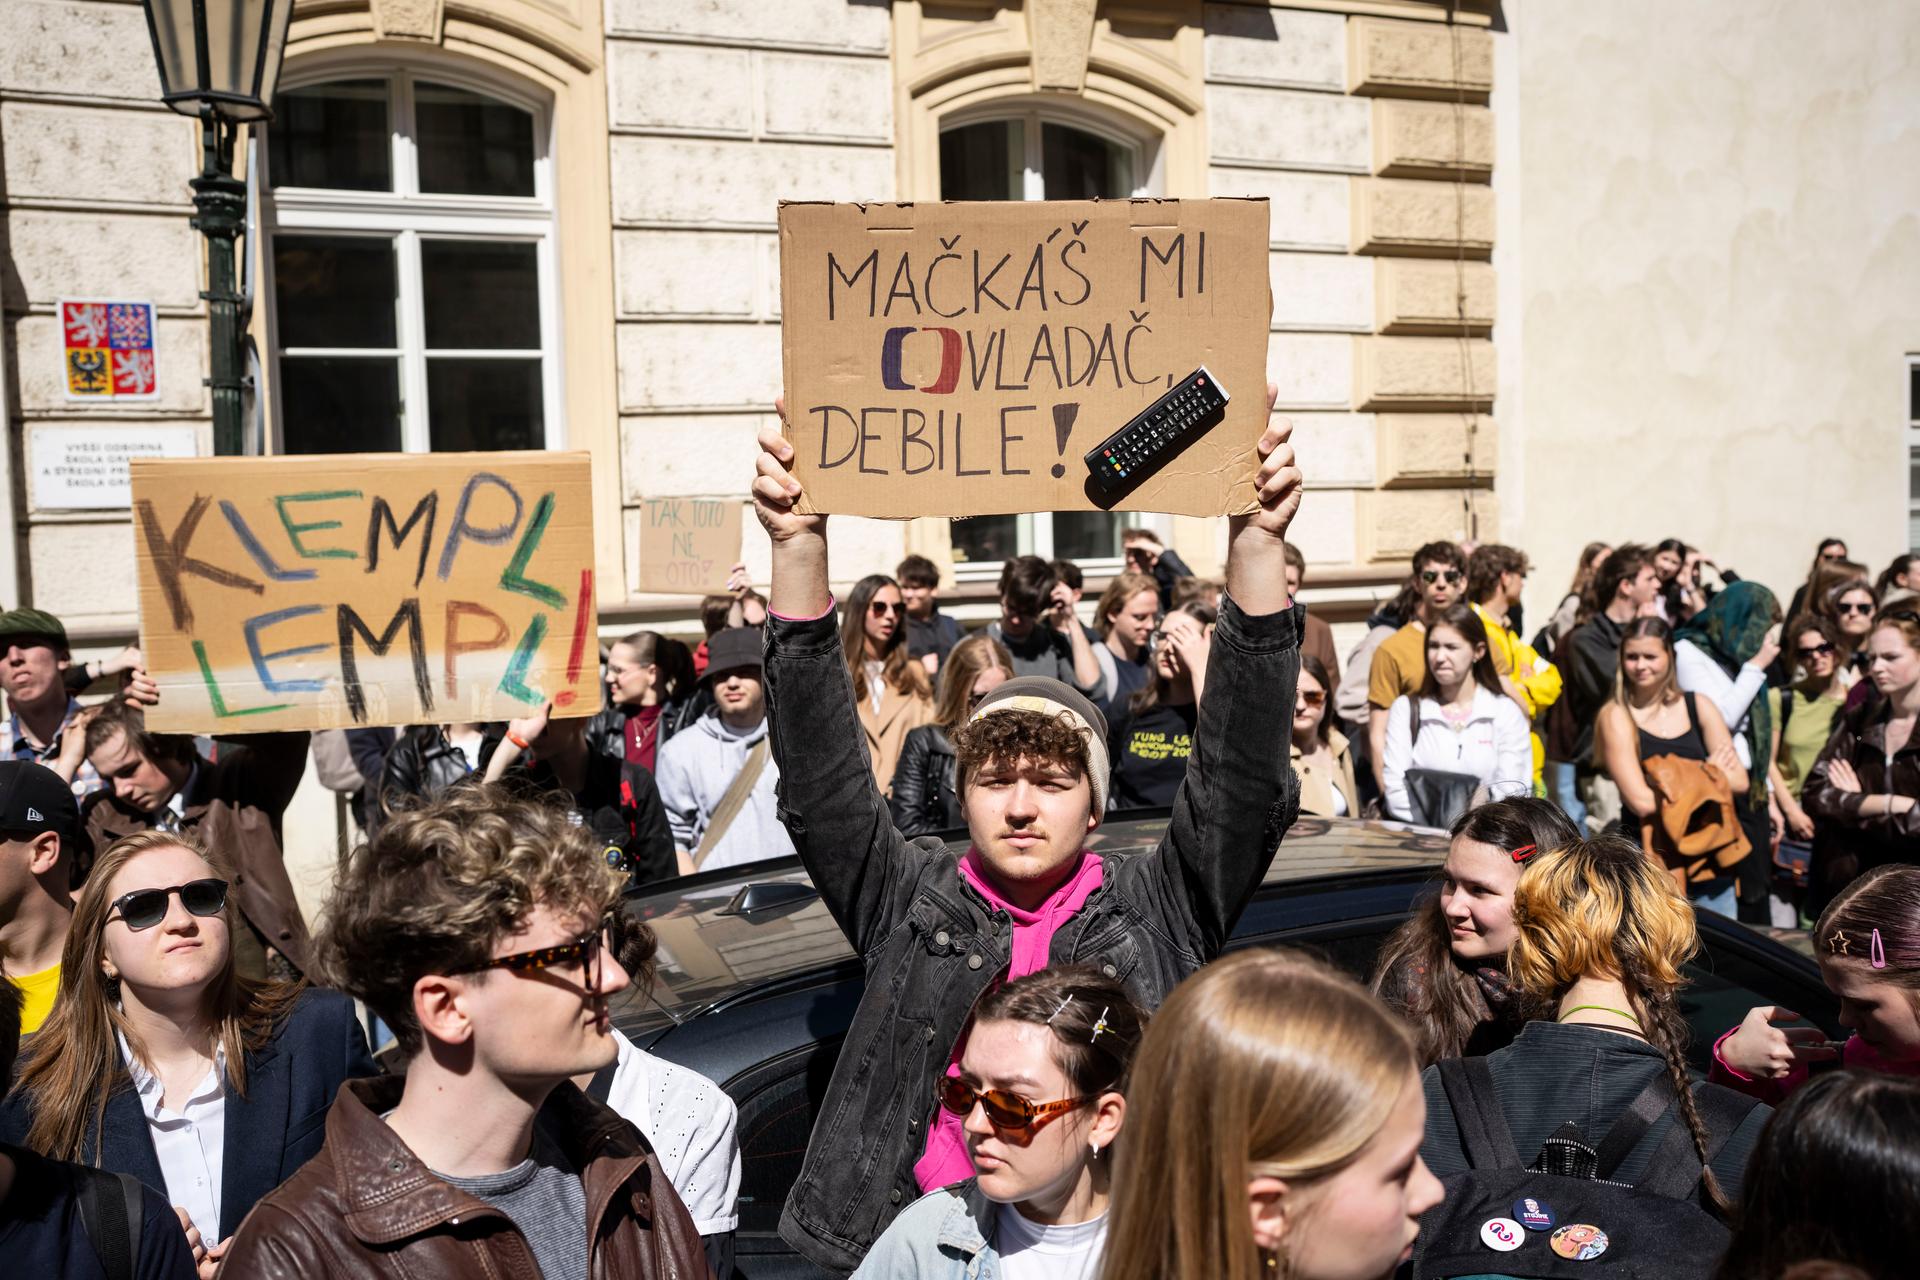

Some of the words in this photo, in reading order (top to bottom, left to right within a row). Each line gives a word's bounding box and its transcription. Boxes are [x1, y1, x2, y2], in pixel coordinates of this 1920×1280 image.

[828, 219, 1092, 321] MAČKÁŠ
[1140, 231, 1205, 303] MI
[808, 402, 1080, 480] DEBILE!
[134, 471, 567, 636] KLEMPL
[645, 500, 685, 528] TAK
[691, 500, 725, 528] TOTO
[192, 568, 593, 724] LEMPL!
[1134, 732, 1165, 742] YUNG
